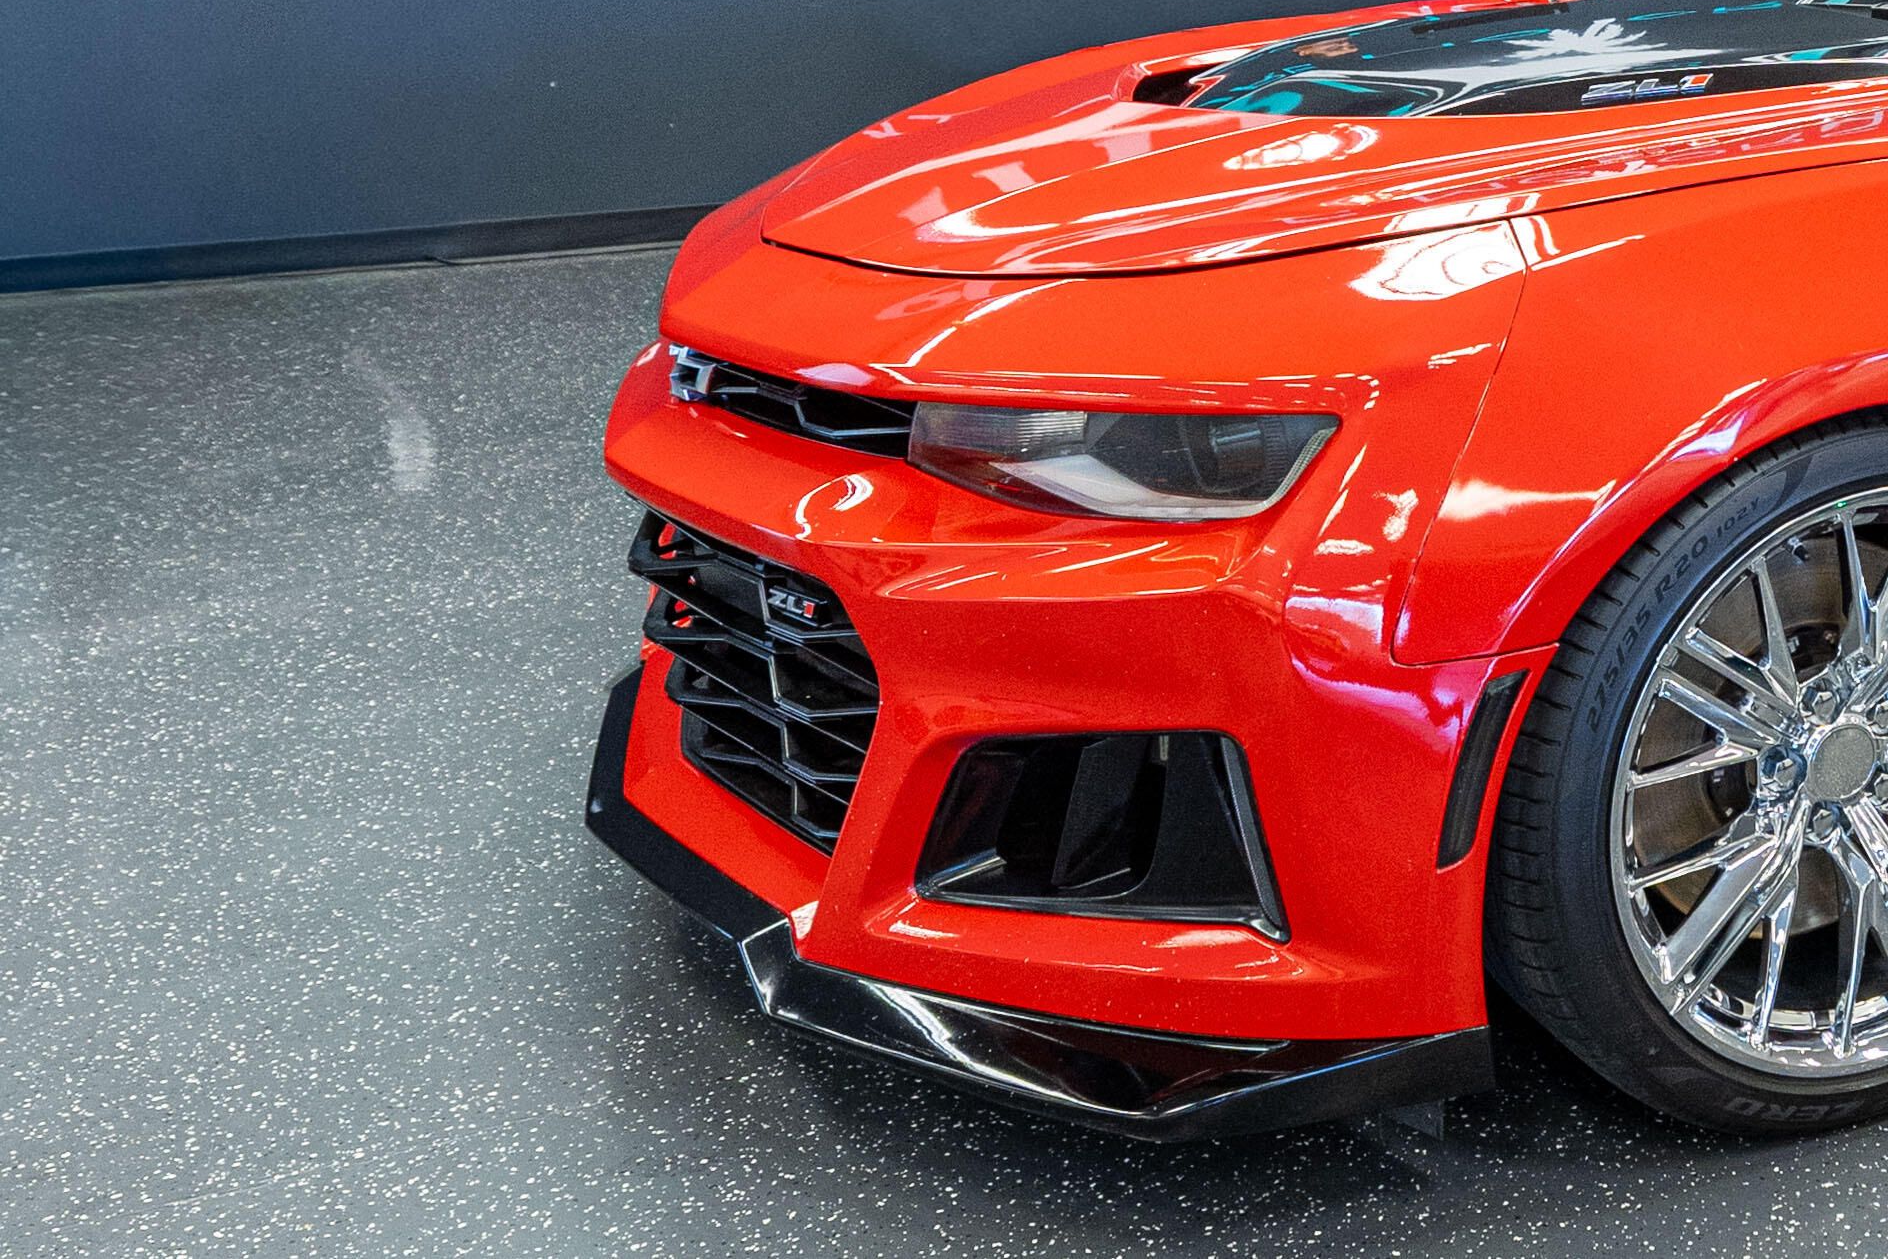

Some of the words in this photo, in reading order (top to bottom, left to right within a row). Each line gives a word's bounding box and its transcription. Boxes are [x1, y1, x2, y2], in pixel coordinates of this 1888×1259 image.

[1581, 73, 1714, 105] ZL1
[767, 587, 816, 619] ZL1
[1586, 602, 1651, 734] 275/35
[1654, 533, 1710, 604] R20
